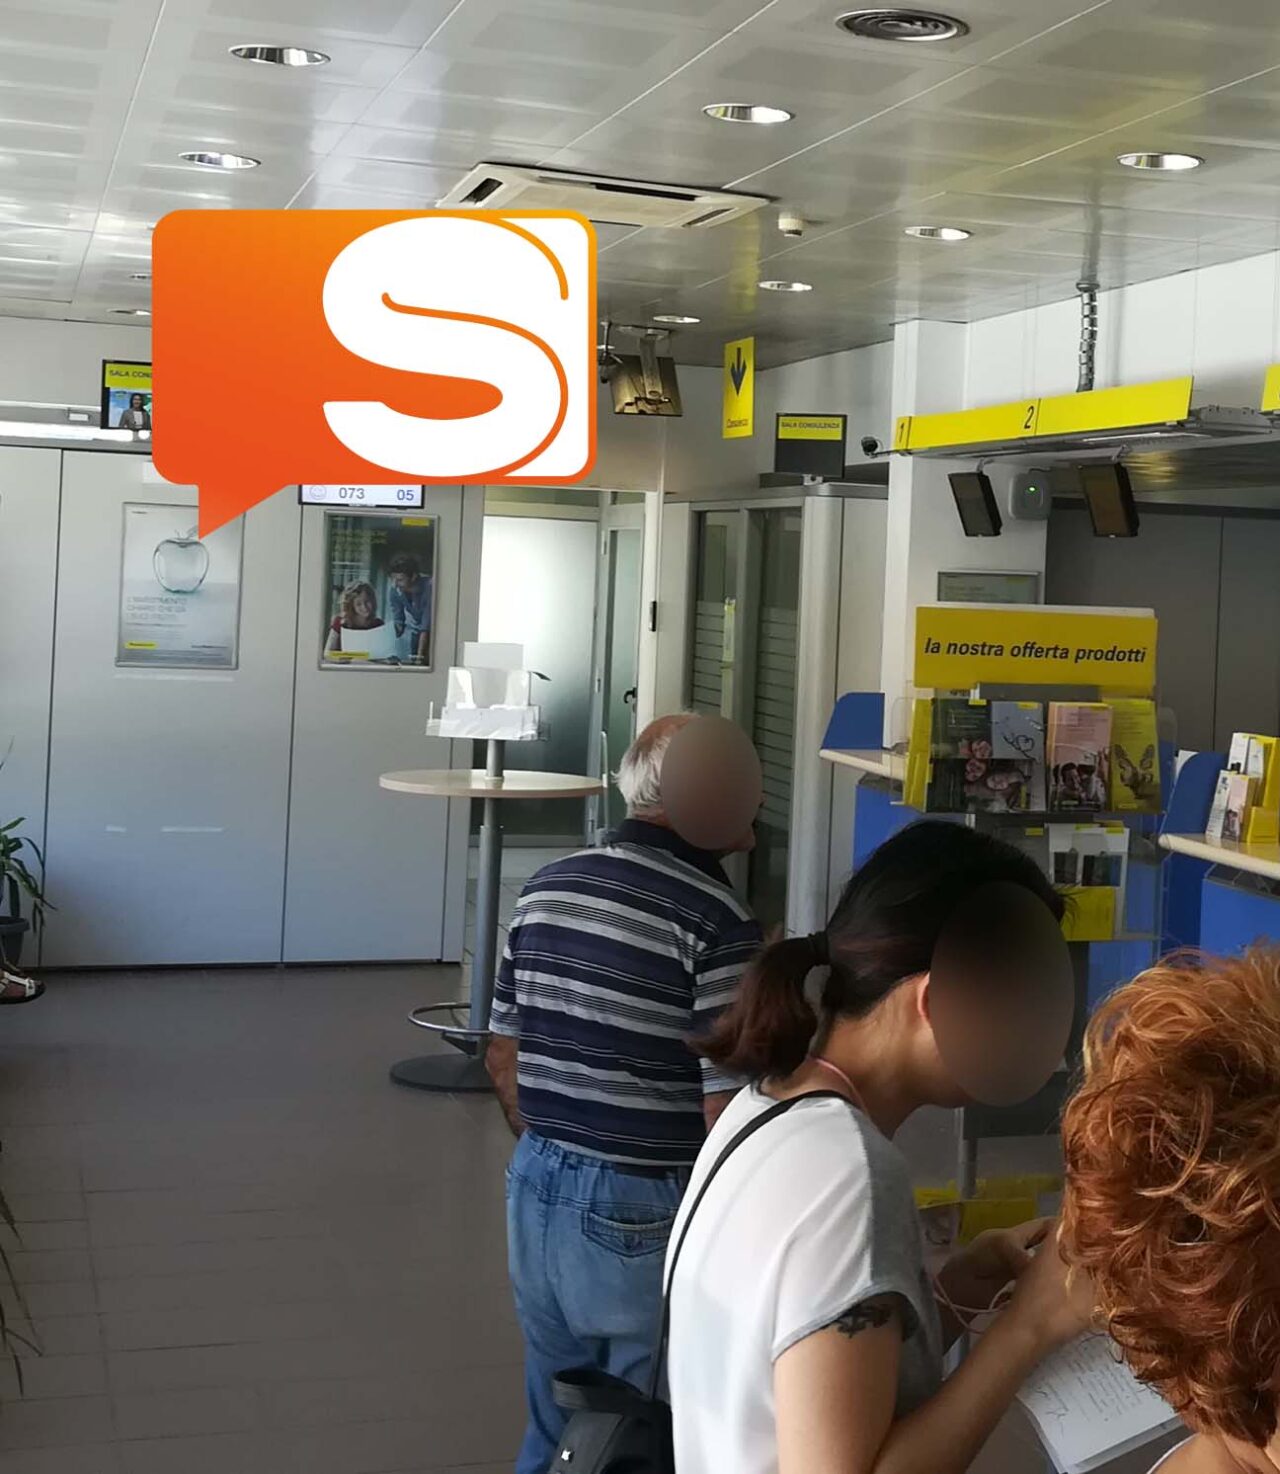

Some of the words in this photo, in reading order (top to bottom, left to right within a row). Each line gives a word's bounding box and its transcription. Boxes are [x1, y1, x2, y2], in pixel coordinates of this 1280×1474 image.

[1024, 405, 1035, 430] 2
[898, 422, 906, 443] 1
[338, 487, 365, 500] 073
[396, 489, 415, 501] 05
[924, 638, 941, 654] la
[946, 640, 1004, 657] nostra
[1010, 641, 1069, 660] offerta
[1074, 645, 1147, 664] prodotti
